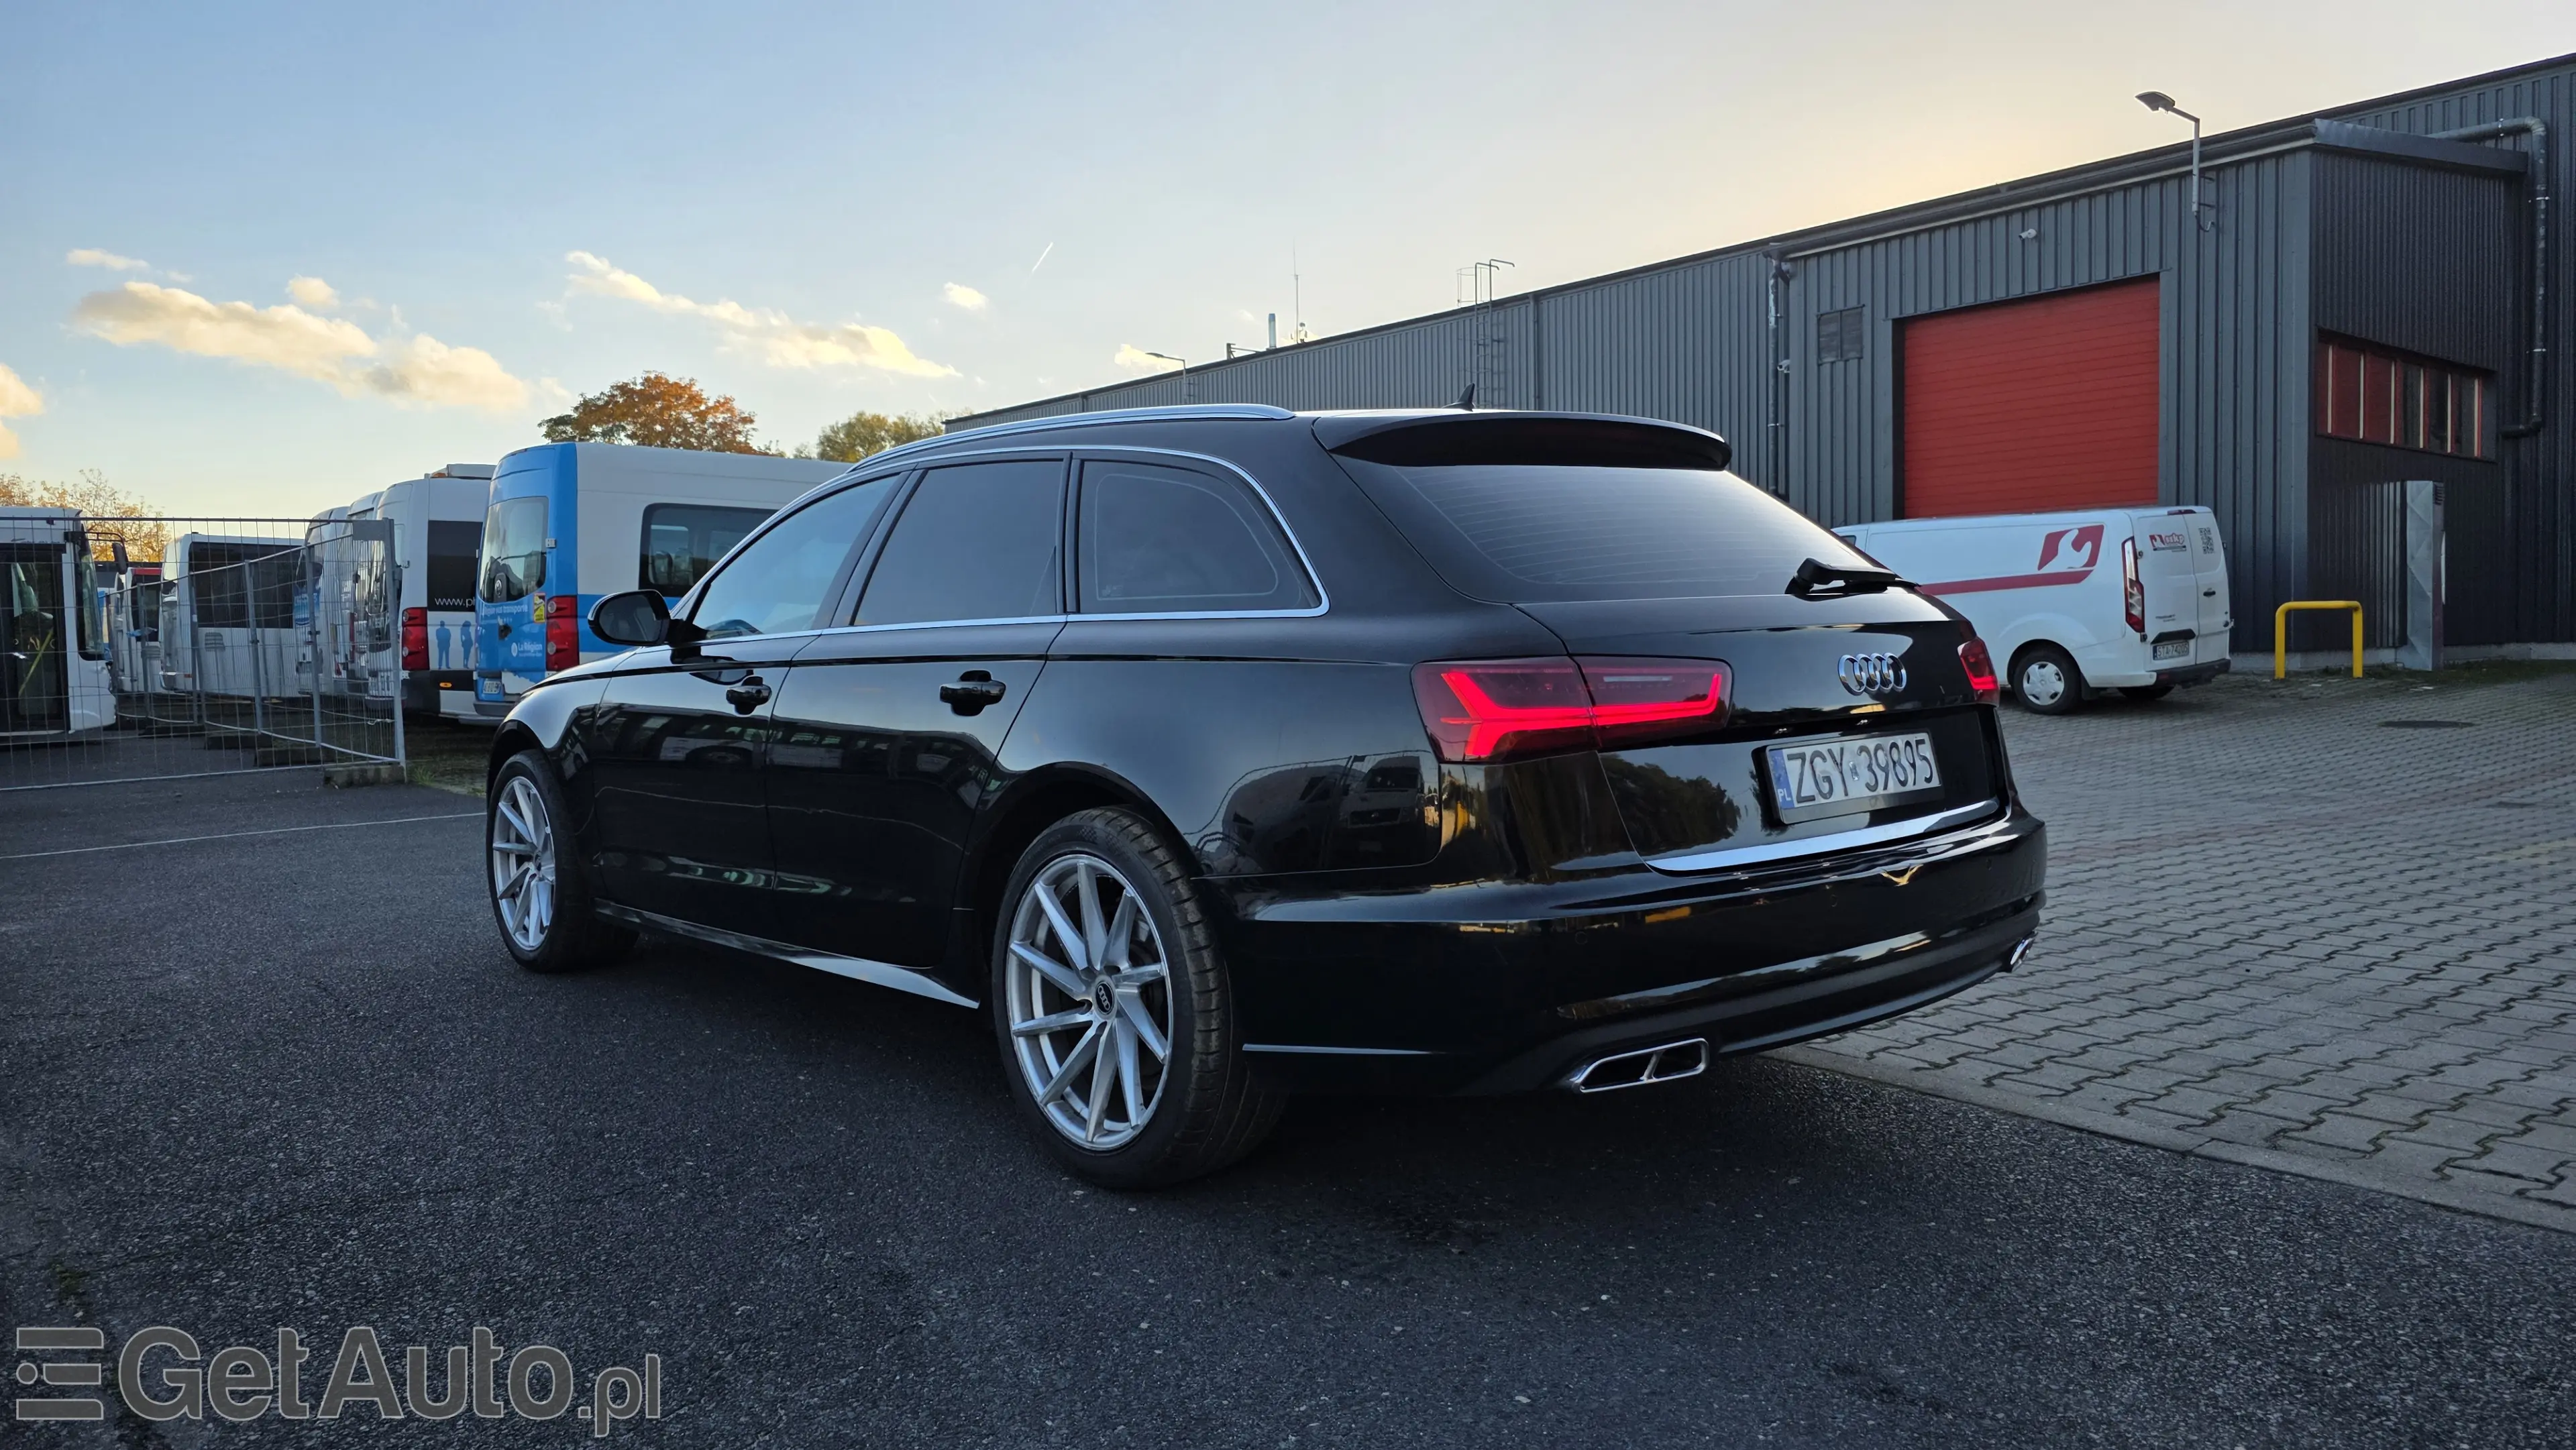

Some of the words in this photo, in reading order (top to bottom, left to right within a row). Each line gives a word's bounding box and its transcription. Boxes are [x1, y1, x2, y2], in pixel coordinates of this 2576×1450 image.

[1786, 746, 1849, 804] ZGY
[1857, 738, 1933, 793] 39895
[1777, 788, 1791, 802] PL
